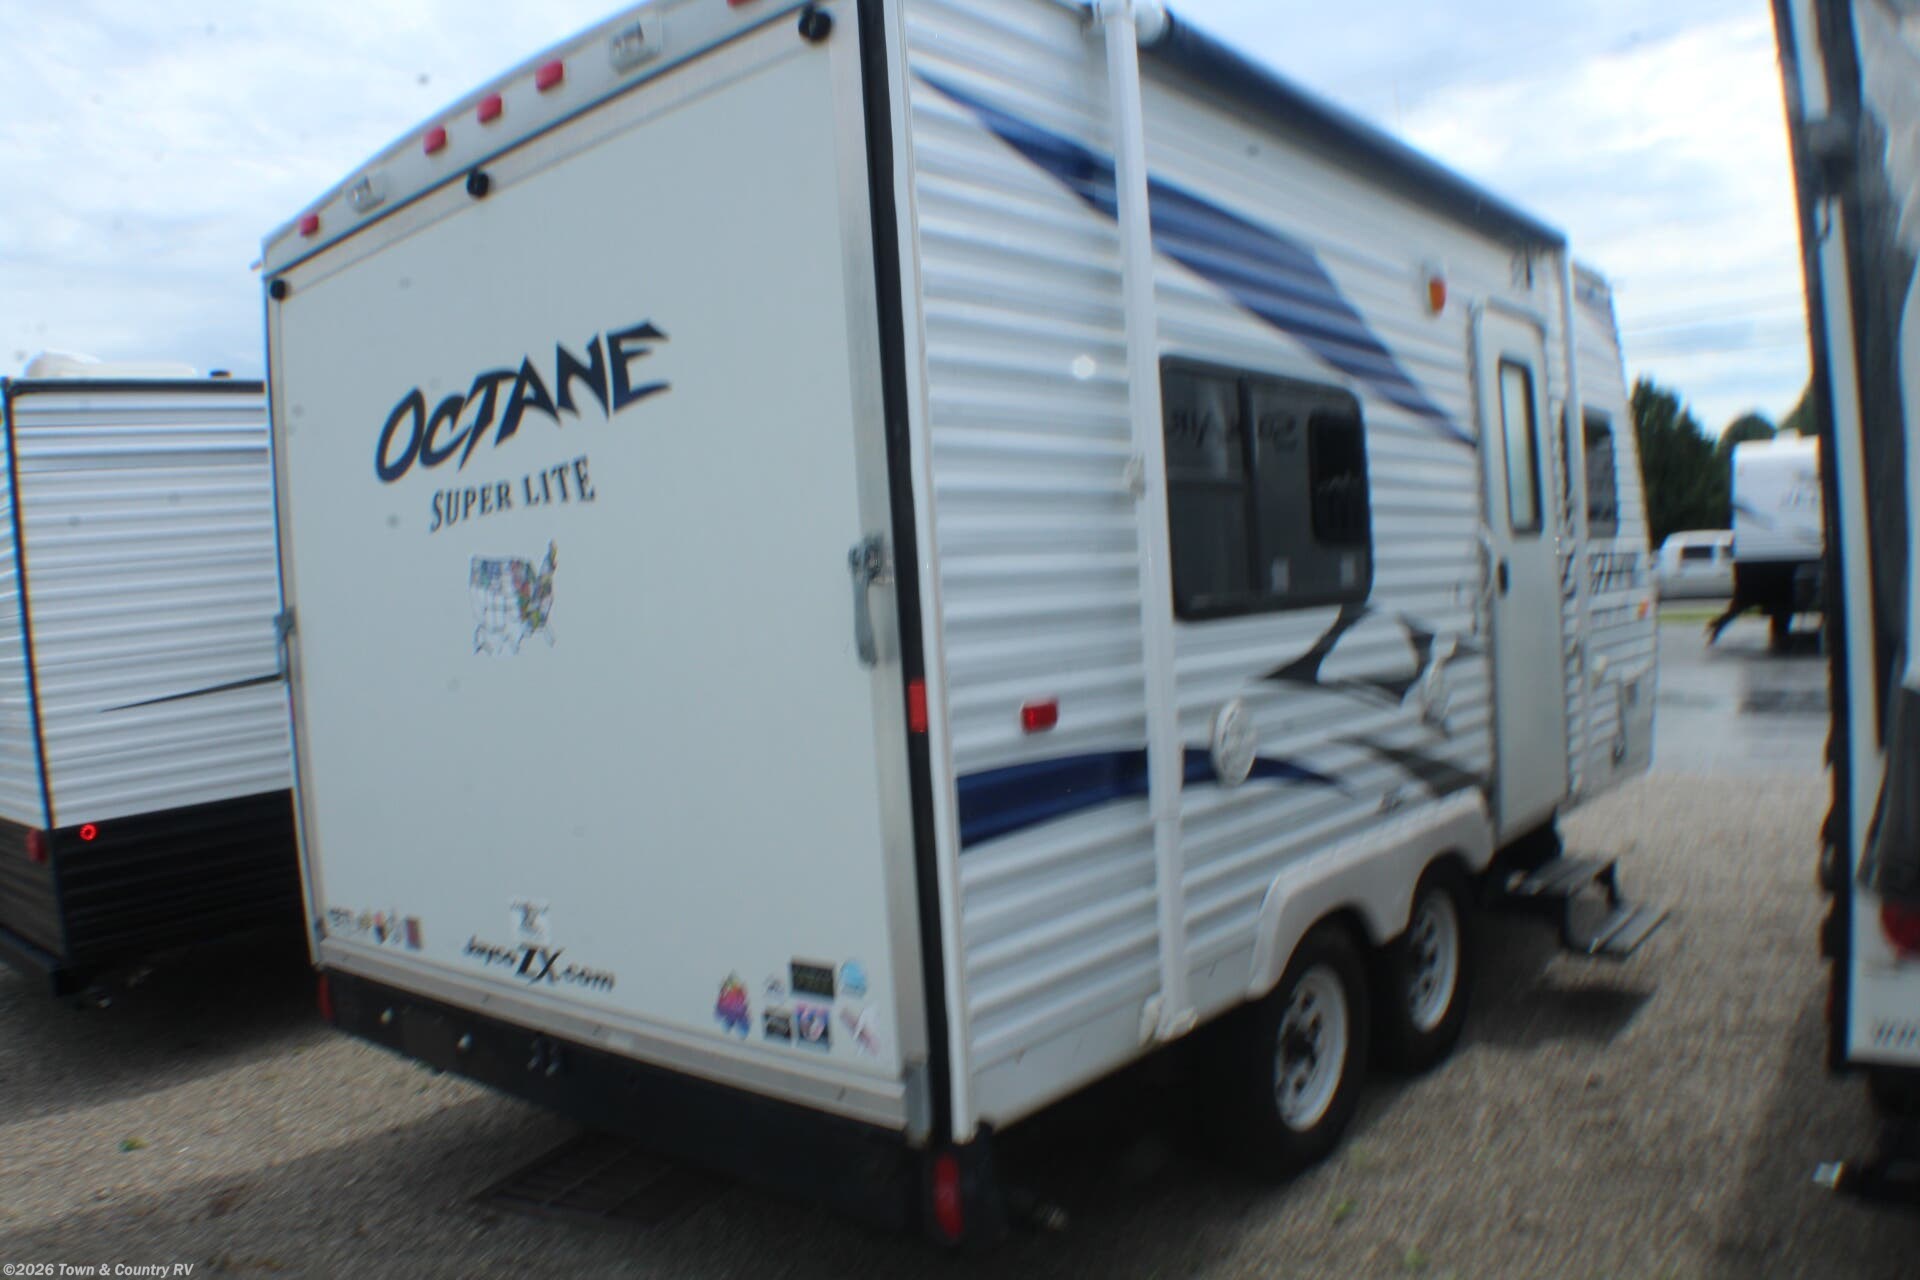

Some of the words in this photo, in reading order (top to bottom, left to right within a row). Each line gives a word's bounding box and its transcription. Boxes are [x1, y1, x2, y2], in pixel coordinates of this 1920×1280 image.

[375, 319, 672, 484] OCTANE
[430, 480, 513, 533] SUPER
[522, 456, 596, 506] LITE
